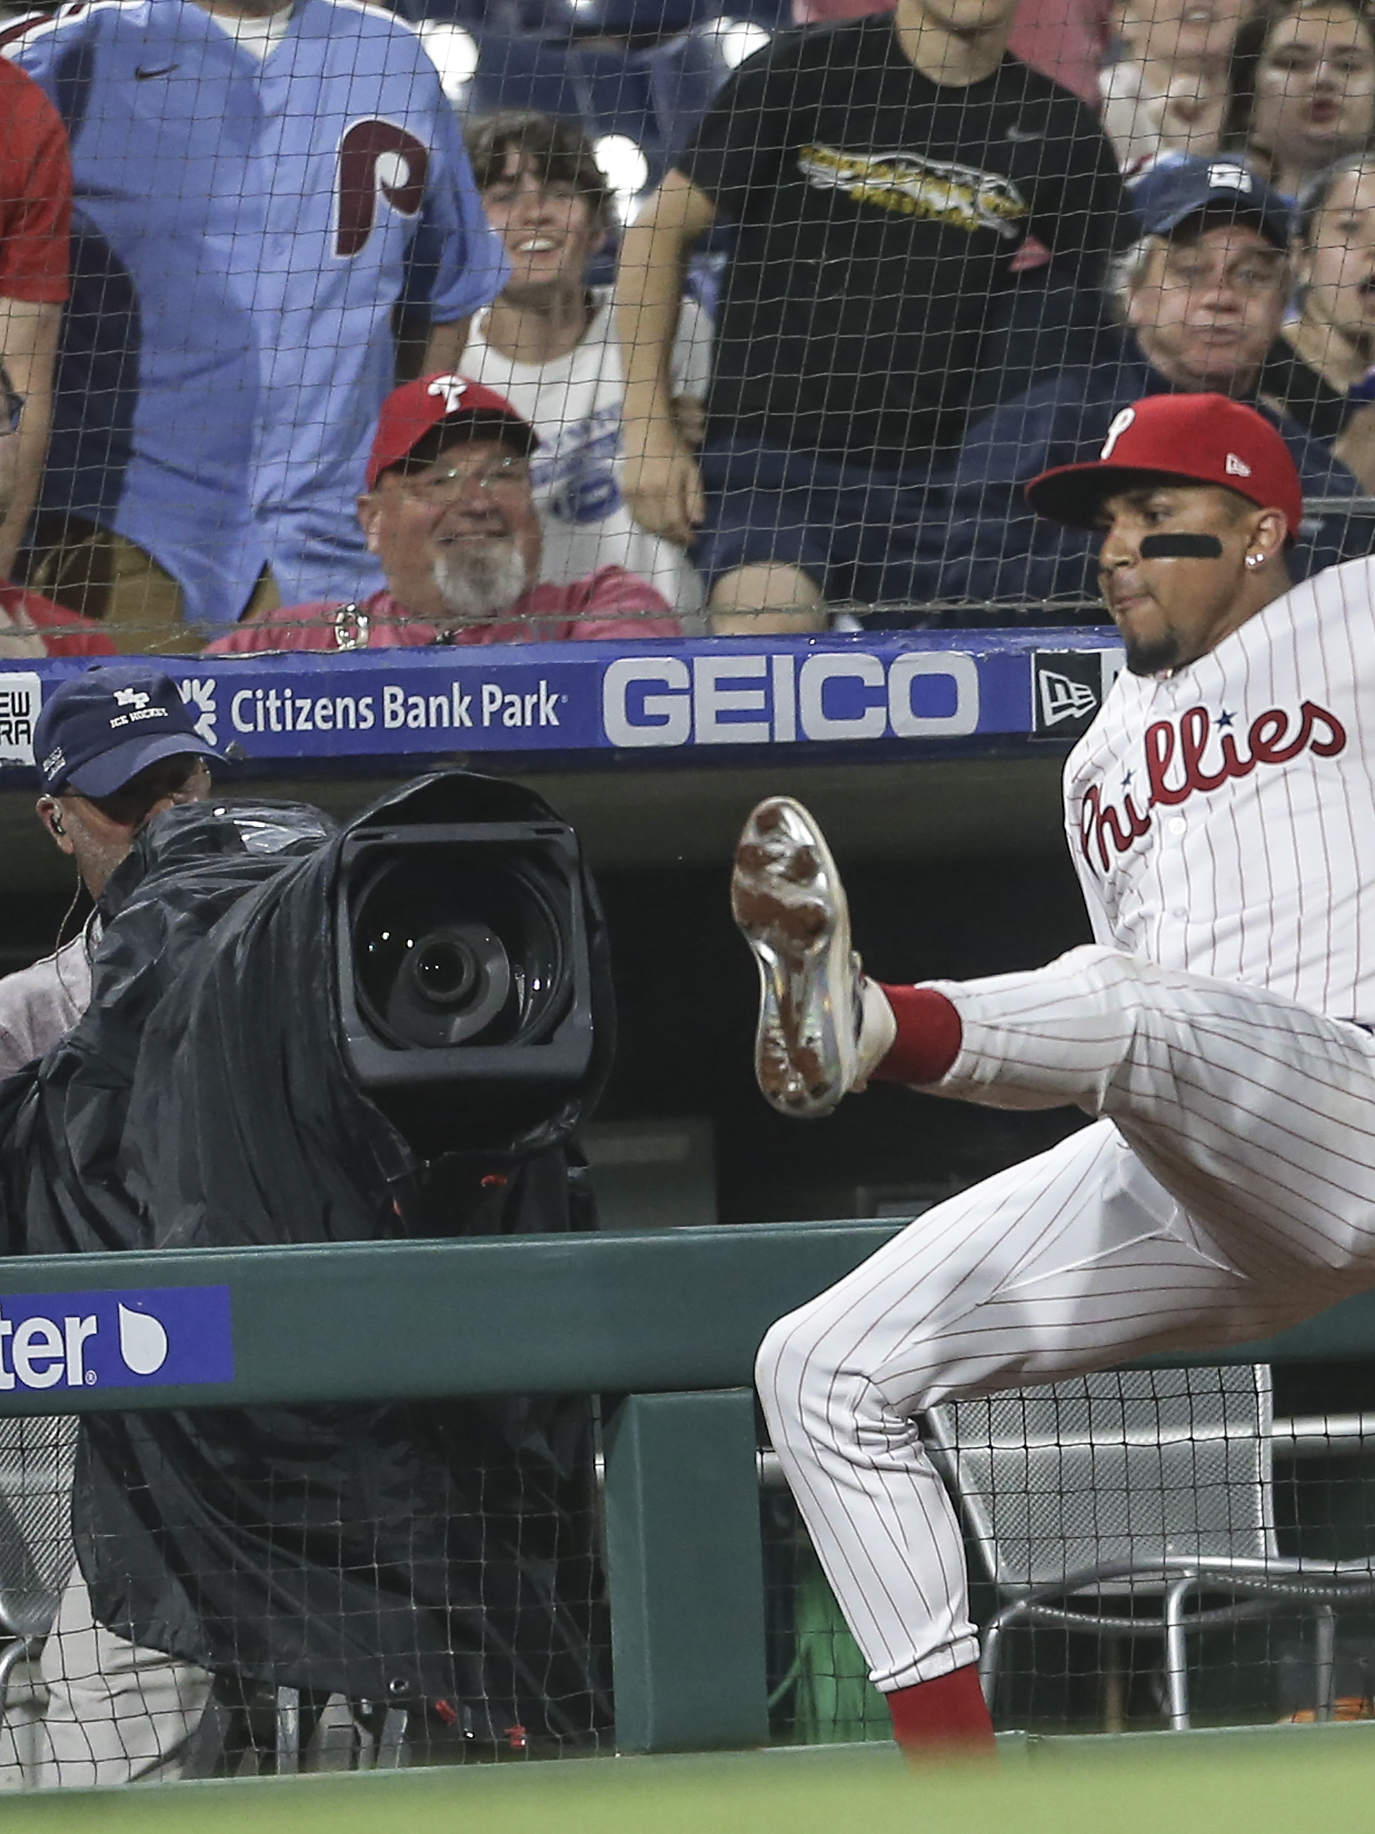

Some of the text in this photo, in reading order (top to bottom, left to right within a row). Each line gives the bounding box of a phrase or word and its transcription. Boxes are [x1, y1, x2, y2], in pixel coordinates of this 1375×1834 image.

[333, 118, 429, 259] P
[1100, 407, 1135, 460] P
[0, 691, 31, 717] EW
[230, 680, 561, 733] Citizens Bank Park
[602, 651, 980, 747] GEICO
[0, 720, 31, 745] RA
[1080, 700, 1347, 874] Phillies
